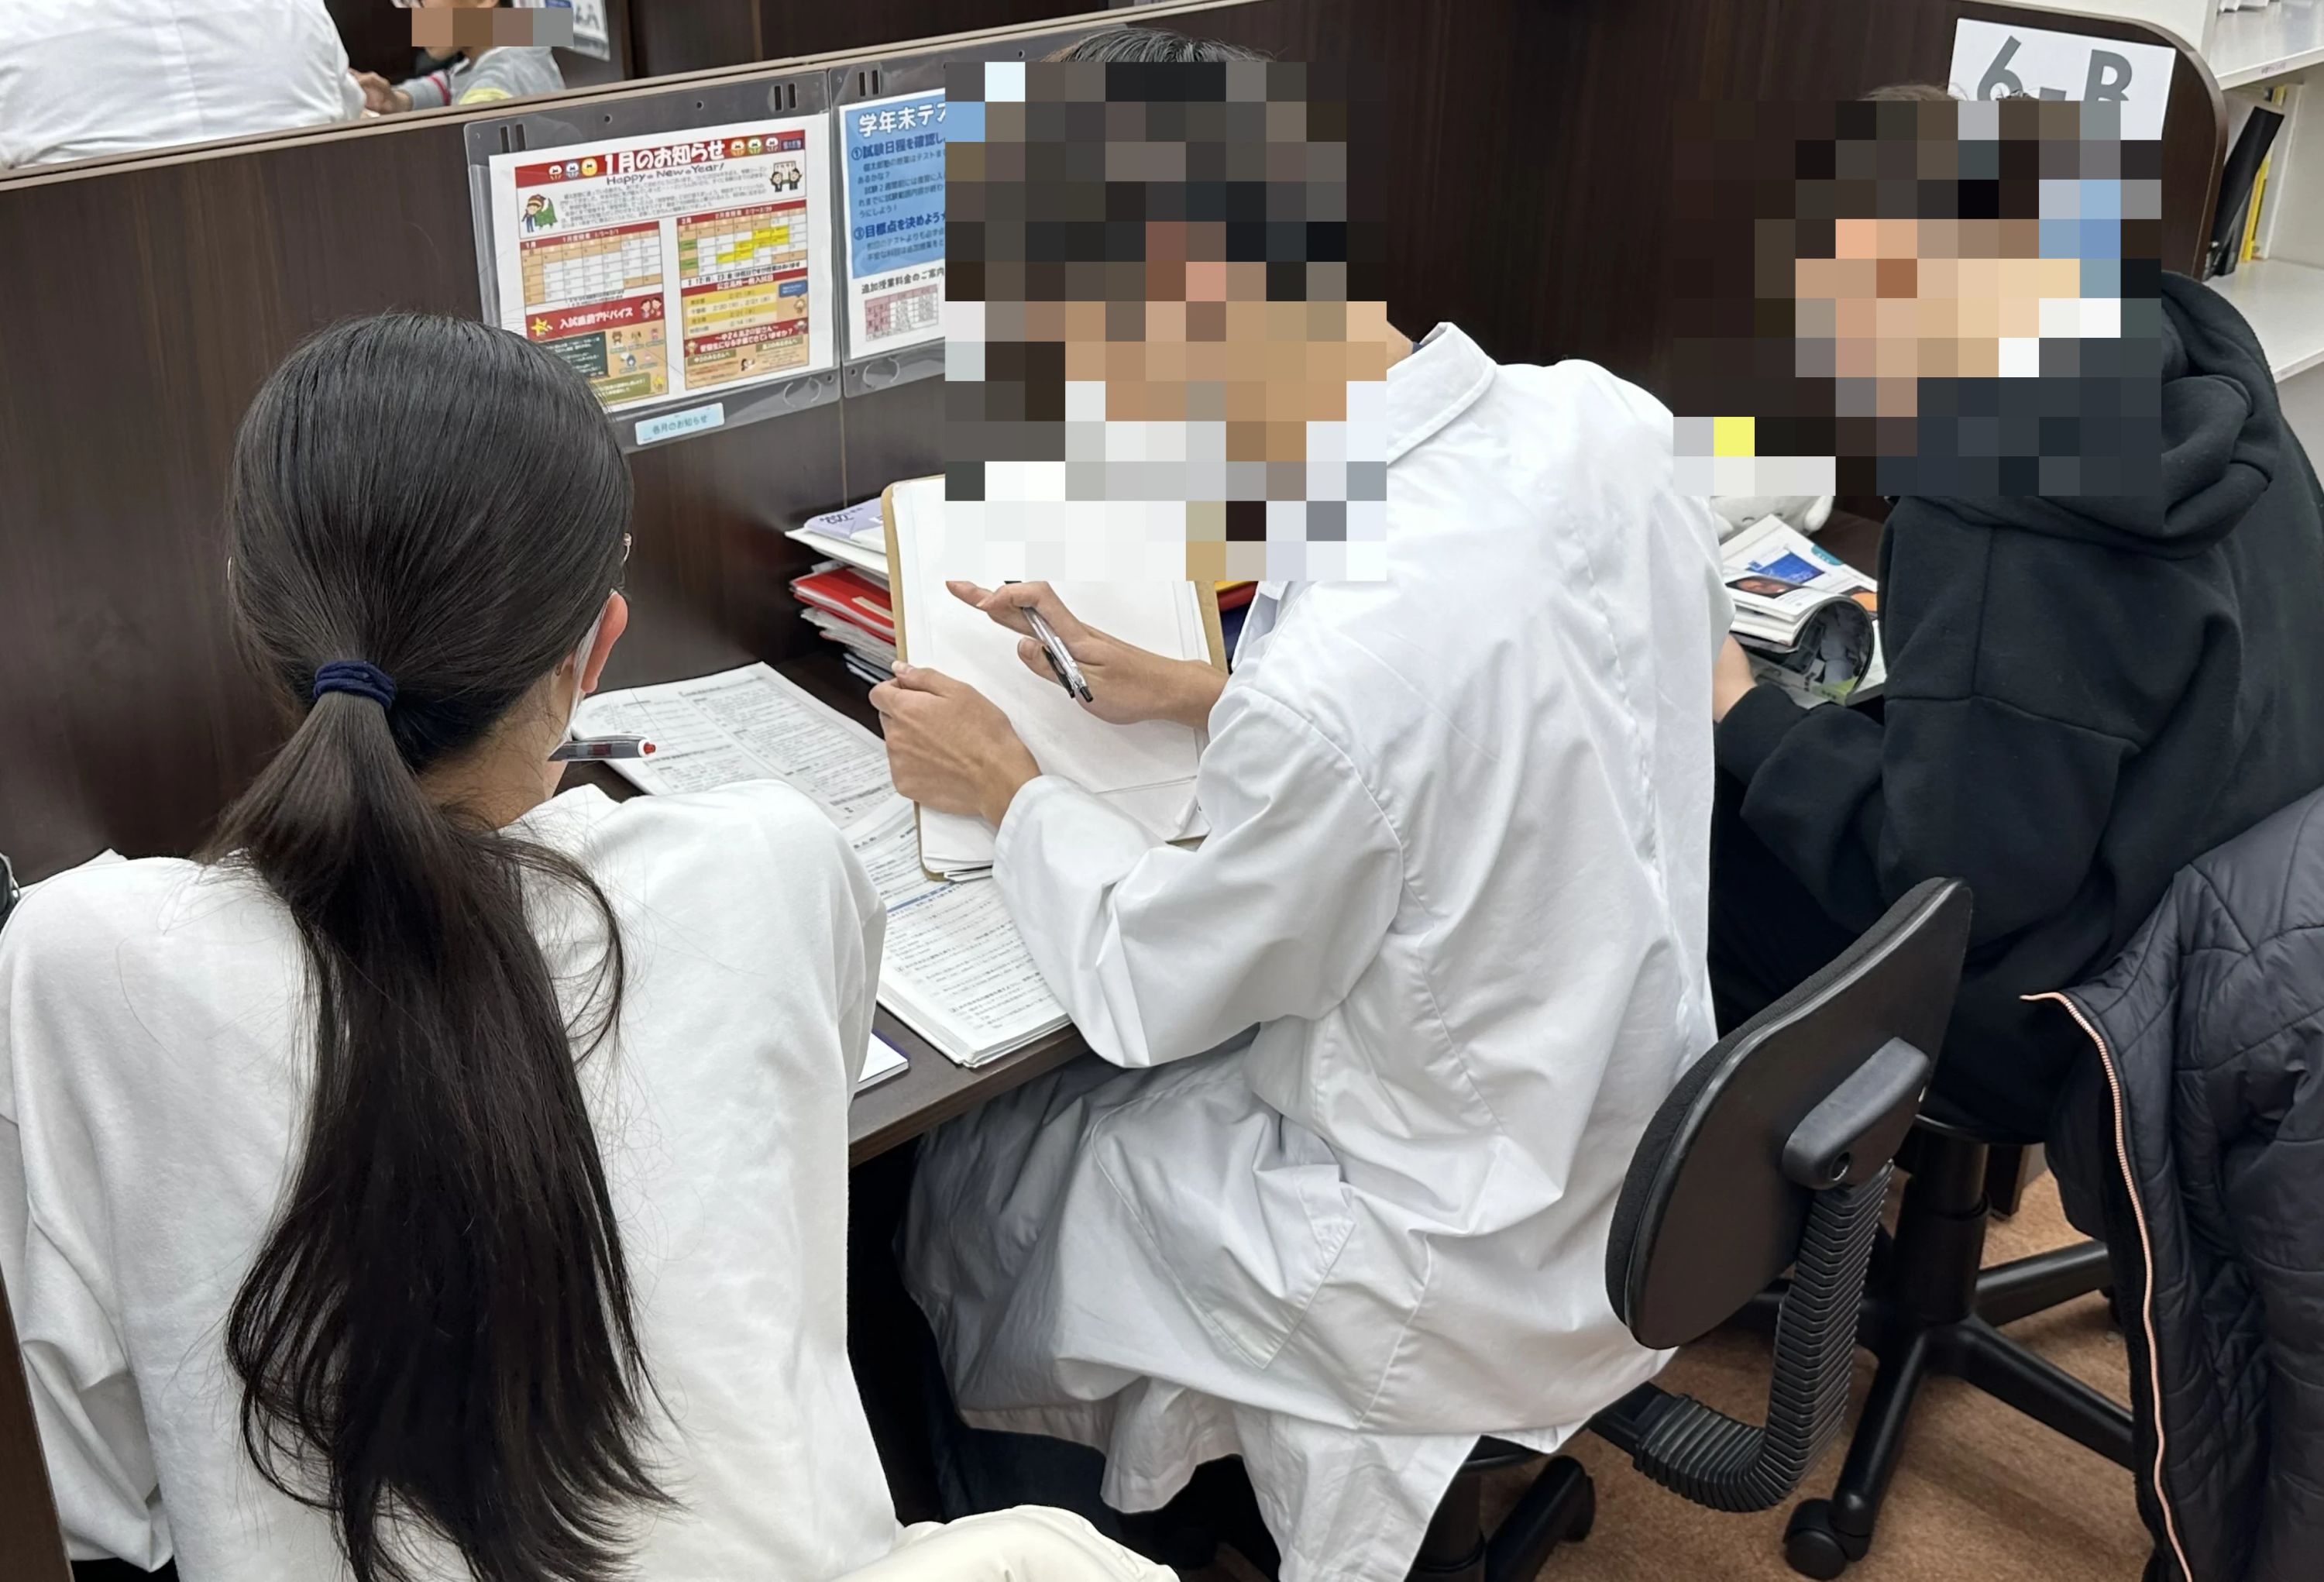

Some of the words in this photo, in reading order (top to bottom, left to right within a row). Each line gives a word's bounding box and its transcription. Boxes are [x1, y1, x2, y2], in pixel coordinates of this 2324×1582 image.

[604, 141, 725, 175] 1月のお知らせ
[607, 174, 646, 185] Happy
[656, 167, 683, 177] New
[692, 163, 724, 174] Year!
[861, 268, 944, 294] 追加授業料金のご案内
